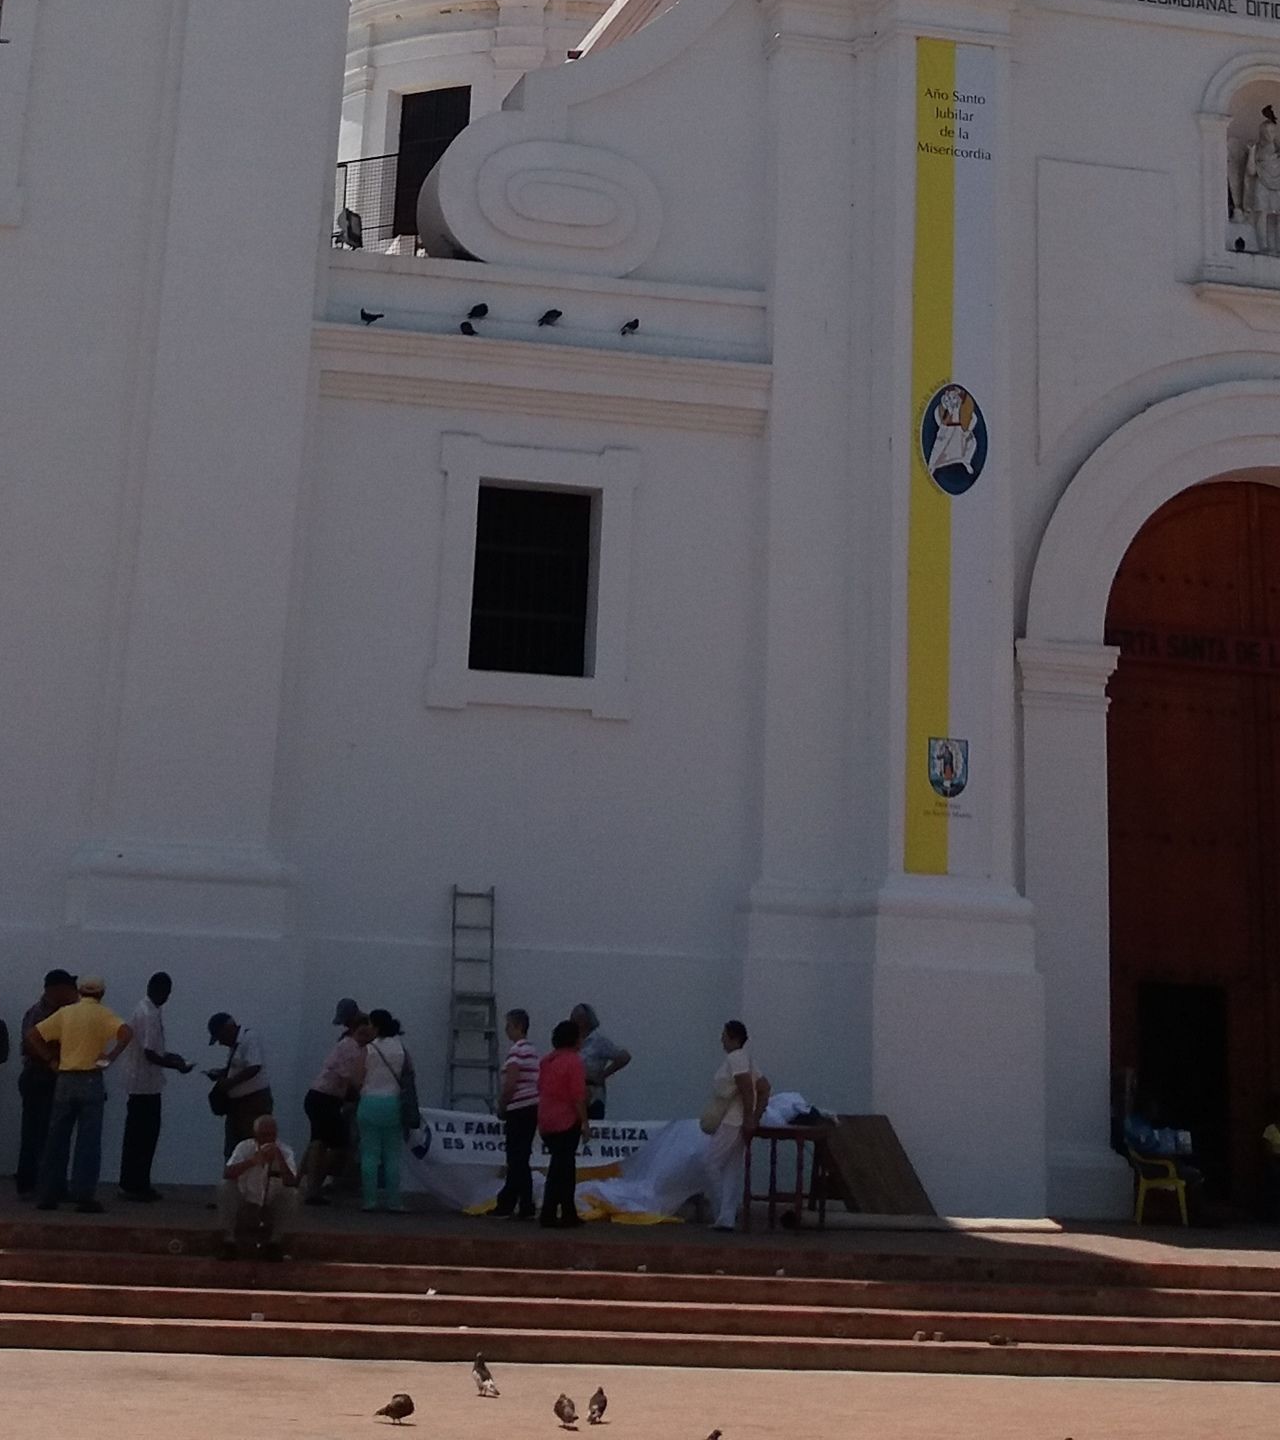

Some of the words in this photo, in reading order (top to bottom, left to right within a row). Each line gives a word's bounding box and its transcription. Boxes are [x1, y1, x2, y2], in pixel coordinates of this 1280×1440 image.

[924, 87, 949, 101] Año
[952, 90, 986, 105] Santo
[939, 125, 955, 138] de
[958, 127, 969, 140] la
[917, 141, 992, 160] Misericordia
[1233, 640, 1262, 667] DE
[435, 1122, 457, 1134] LA
[442, 1137, 465, 1150] ES
